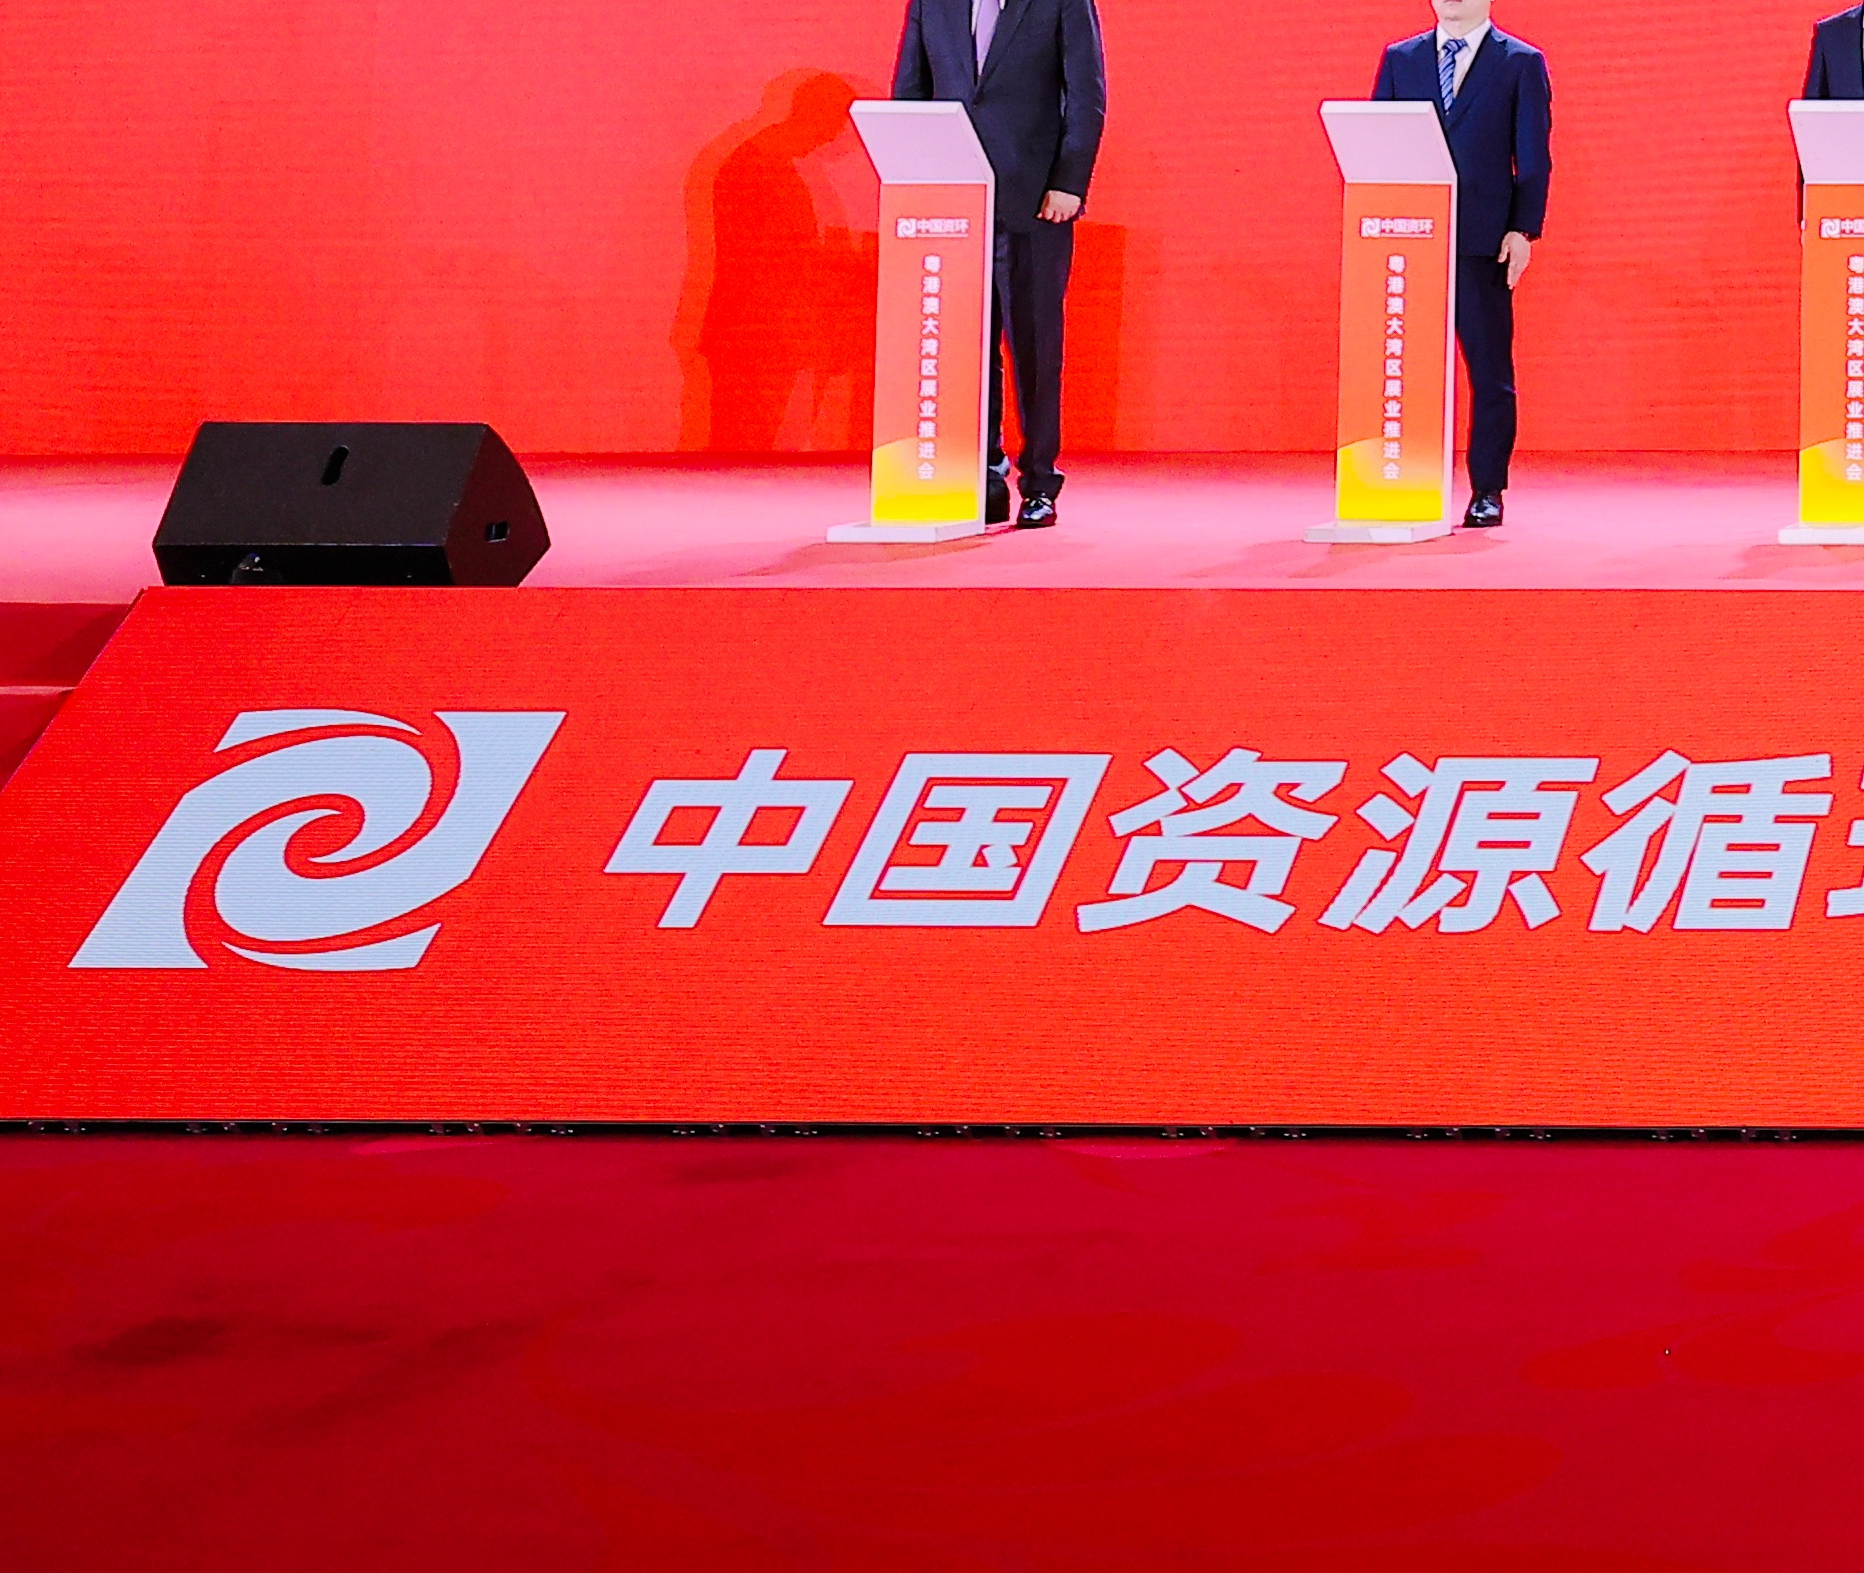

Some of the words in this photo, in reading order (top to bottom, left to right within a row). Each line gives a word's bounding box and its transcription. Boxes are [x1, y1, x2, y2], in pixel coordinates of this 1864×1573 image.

[918, 254, 942, 481] 粤港澳大湾区展业推进会
[1383, 254, 1404, 481] 粤港澳大湾区展业推进会
